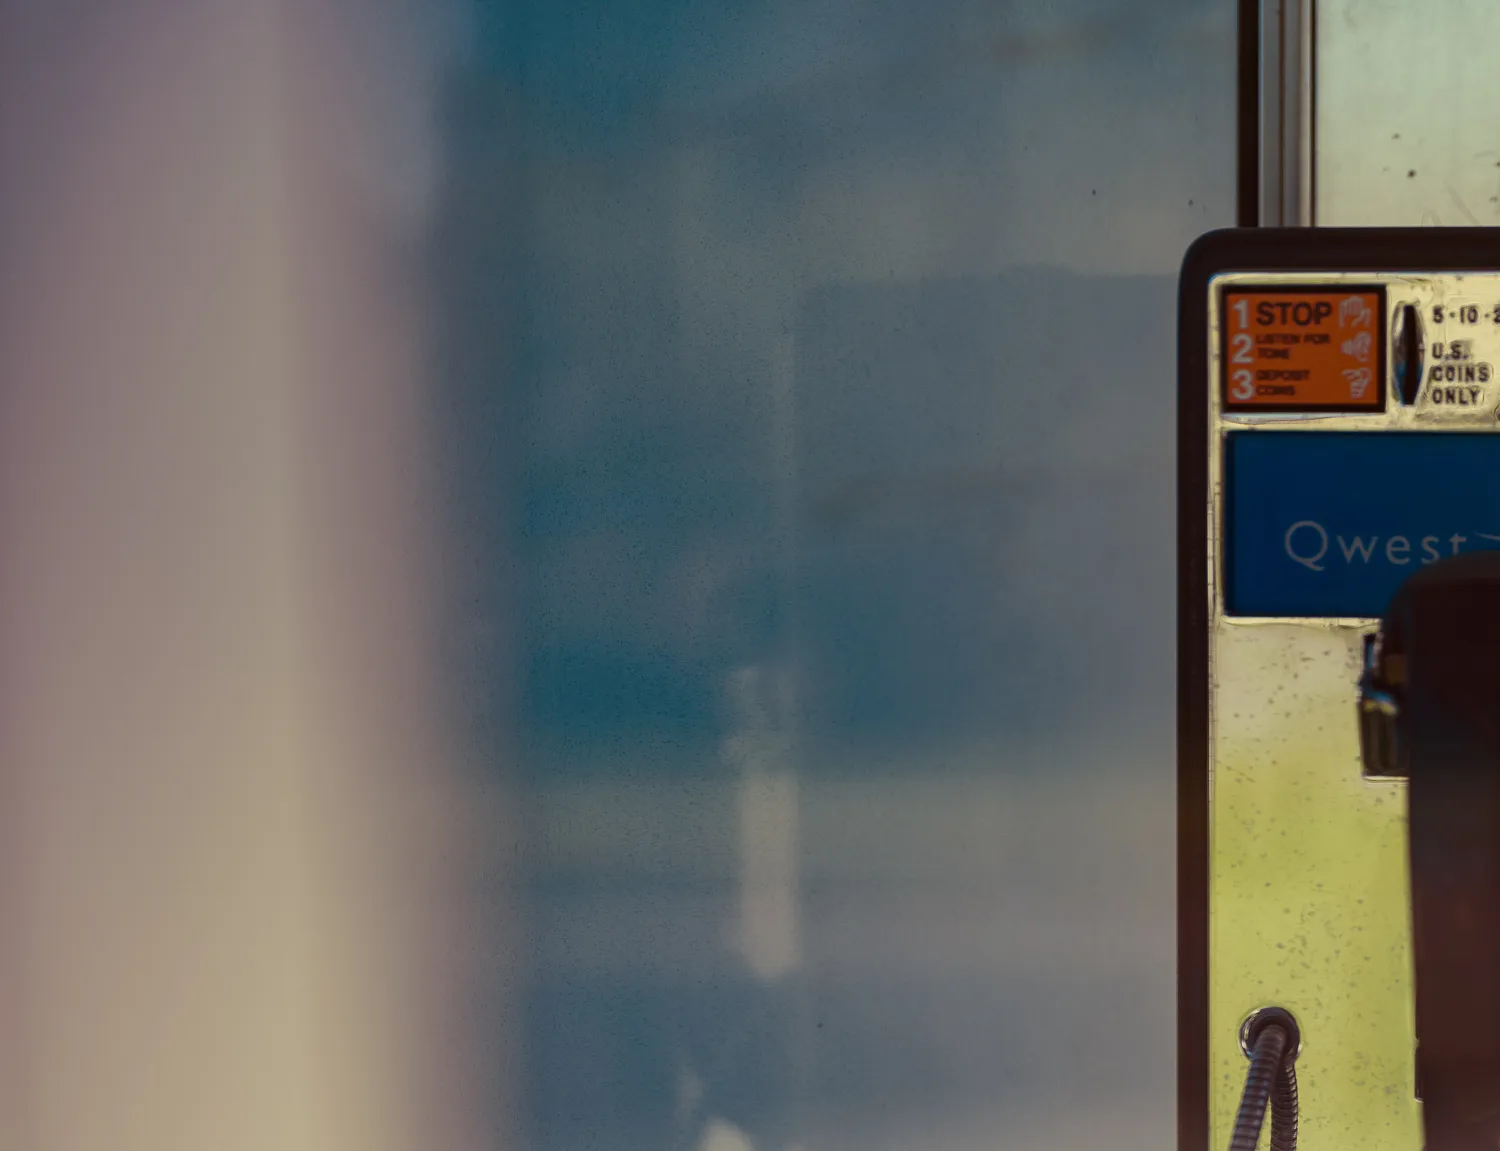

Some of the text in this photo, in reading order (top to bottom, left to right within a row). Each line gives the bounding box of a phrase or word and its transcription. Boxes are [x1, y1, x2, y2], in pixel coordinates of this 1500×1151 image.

[1233, 300, 1332, 329] 1 STOP
[1232, 334, 1255, 364] 2
[1303, 334, 1329, 344] FOR
[1432, 343, 1469, 359] U.S.
[1232, 369, 1253, 400] 3
[1433, 365, 1489, 381] COINS
[1432, 388, 1479, 404] ONLY
[1284, 520, 1467, 571] Qwest
